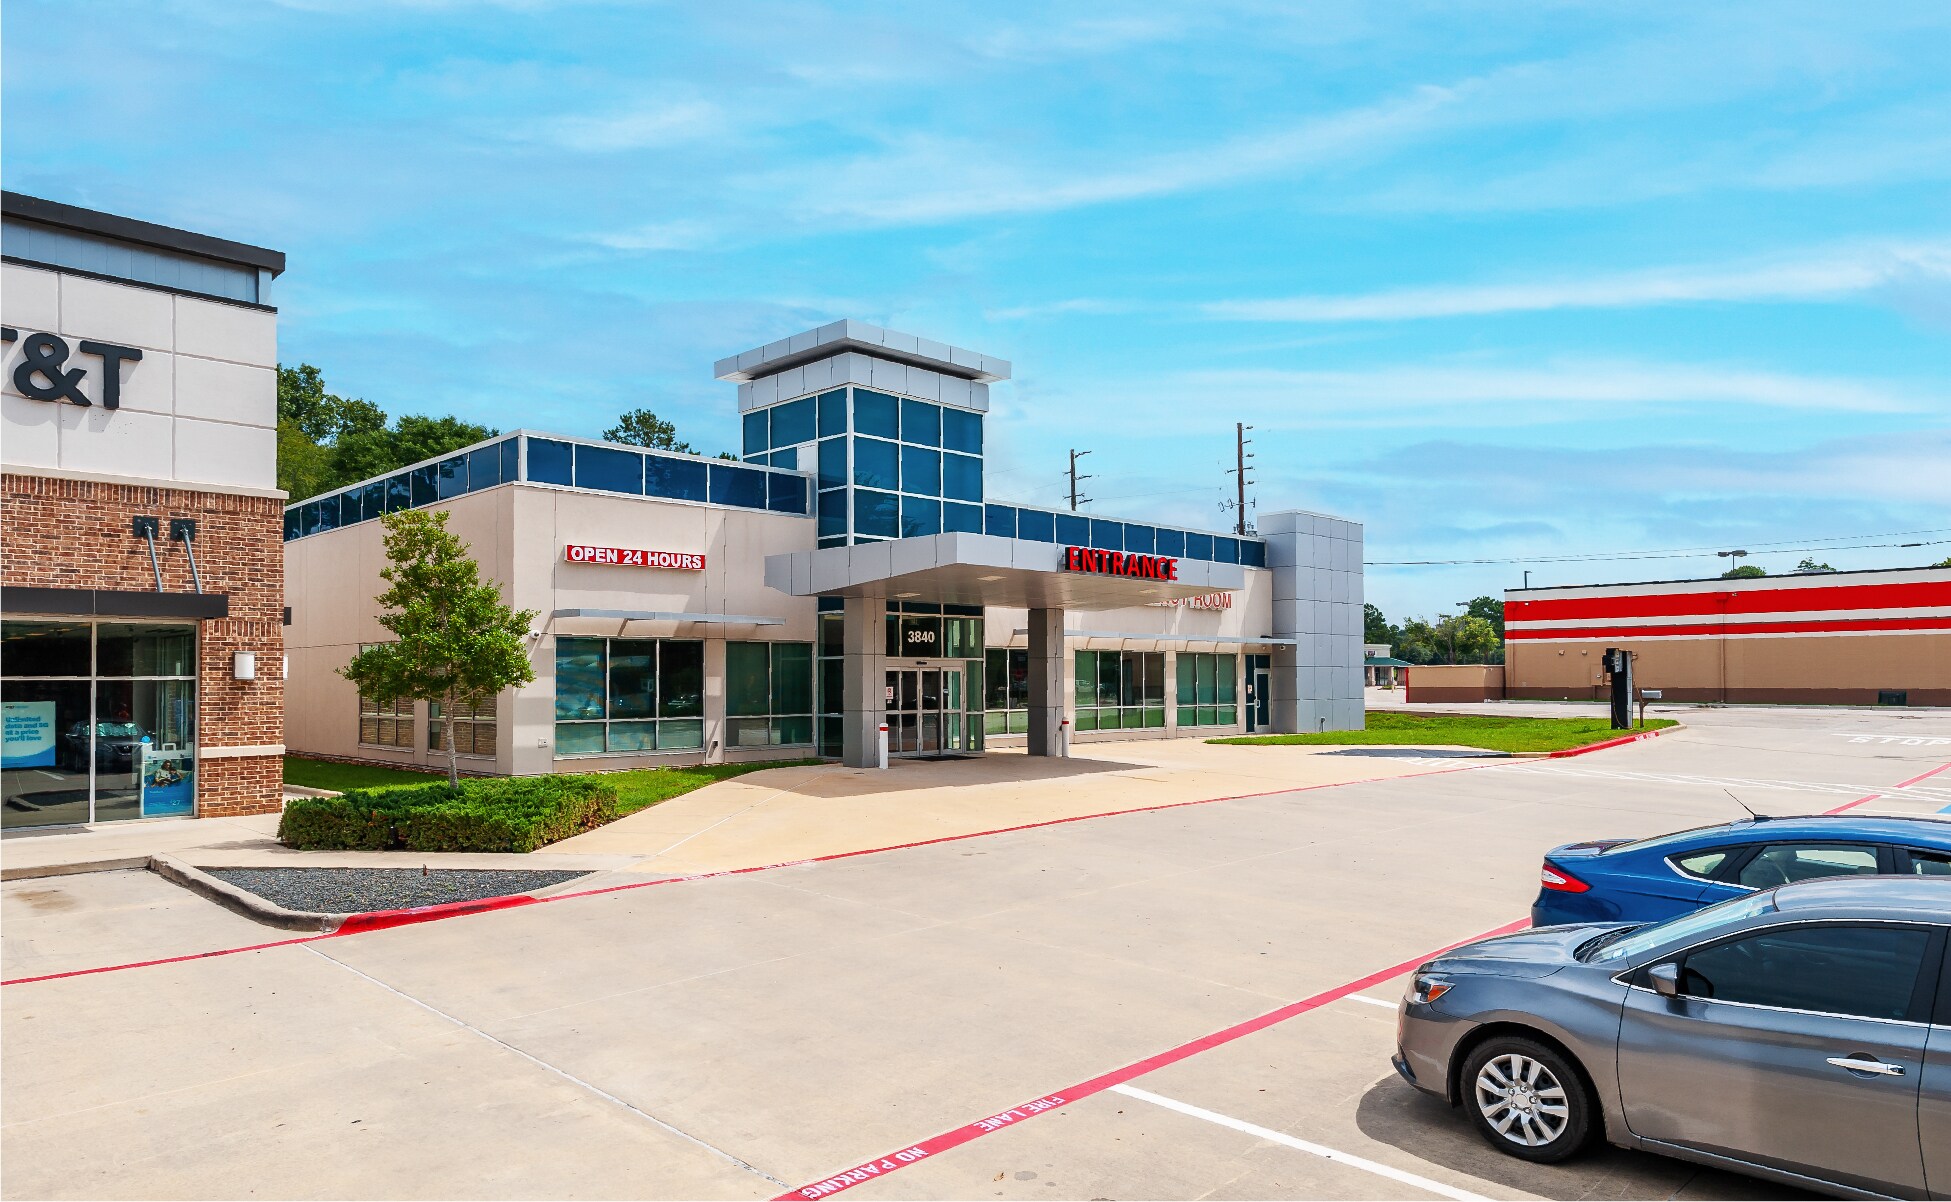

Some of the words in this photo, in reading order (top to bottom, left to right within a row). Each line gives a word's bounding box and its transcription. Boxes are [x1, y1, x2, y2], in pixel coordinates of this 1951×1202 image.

[1, 327, 143, 410] &T
[571, 546, 618, 563] OPEN
[623, 550, 643, 565] 24
[647, 552, 702, 569] HOURS
[1068, 546, 1179, 581] ENTRANCE
[1194, 592, 1232, 609] ROOM
[907, 631, 935, 643] 3840
[1847, 736, 1951, 746] STOP
[1021, 1096, 1066, 1113] FIRE
[973, 1110, 1028, 1132] LANE
[895, 1146, 929, 1162] NO
[800, 1159, 898, 1199] PARKING
